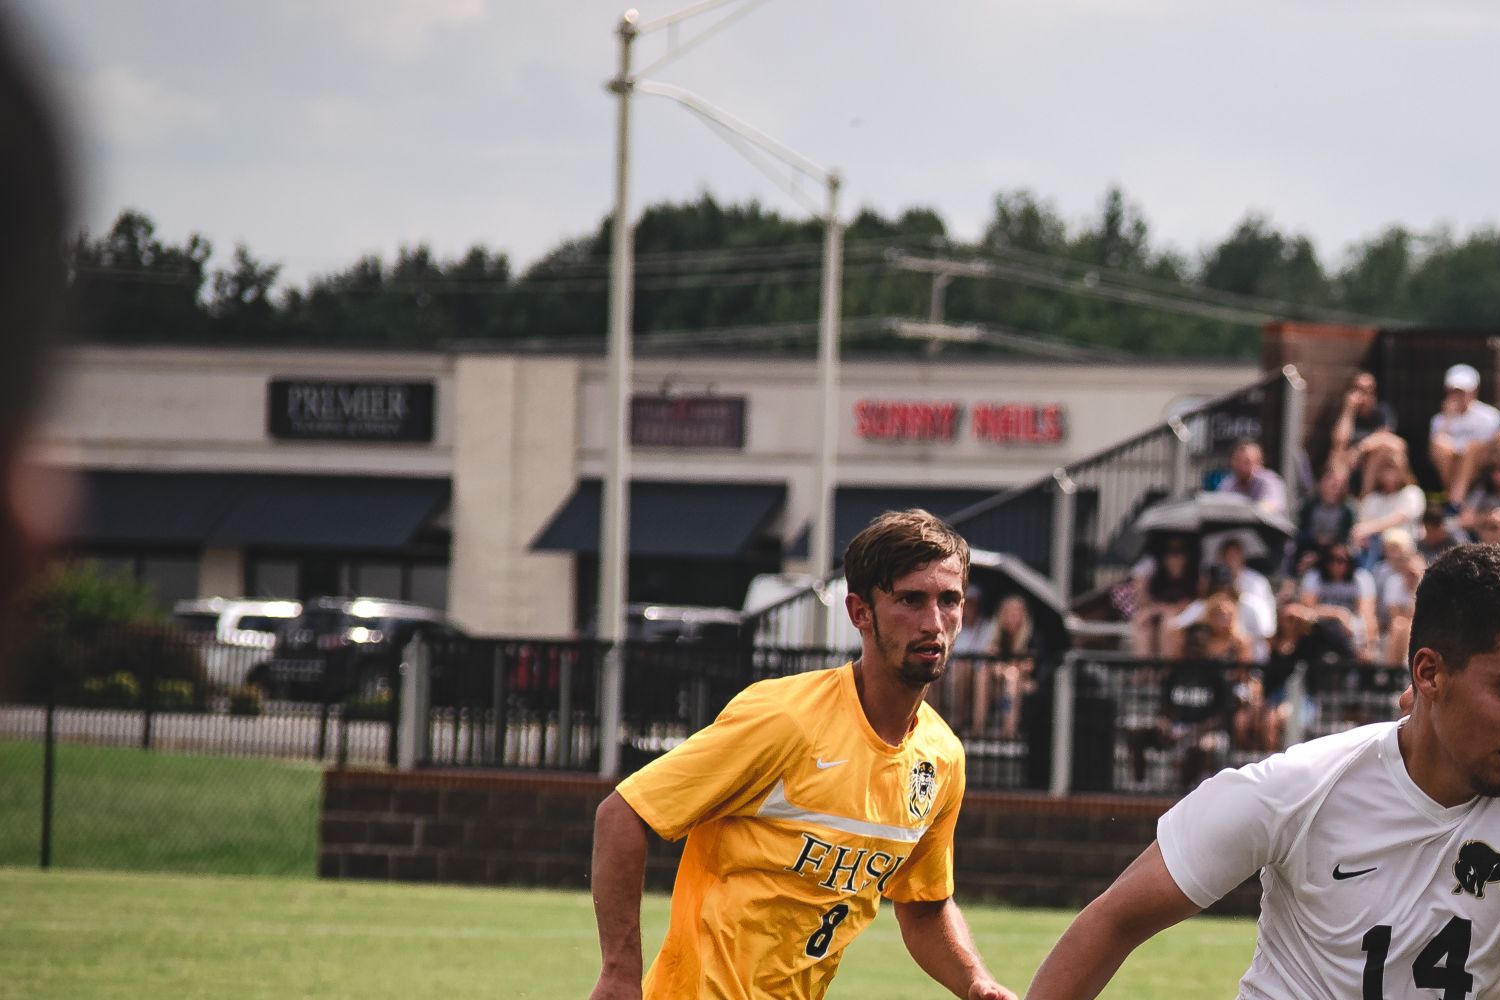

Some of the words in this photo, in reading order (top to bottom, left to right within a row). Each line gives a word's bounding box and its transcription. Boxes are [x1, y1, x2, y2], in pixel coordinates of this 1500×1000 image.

[287, 386, 408, 419] PREMIER
[973, 403, 1063, 441] NAILS
[805, 902, 849, 960] 8
